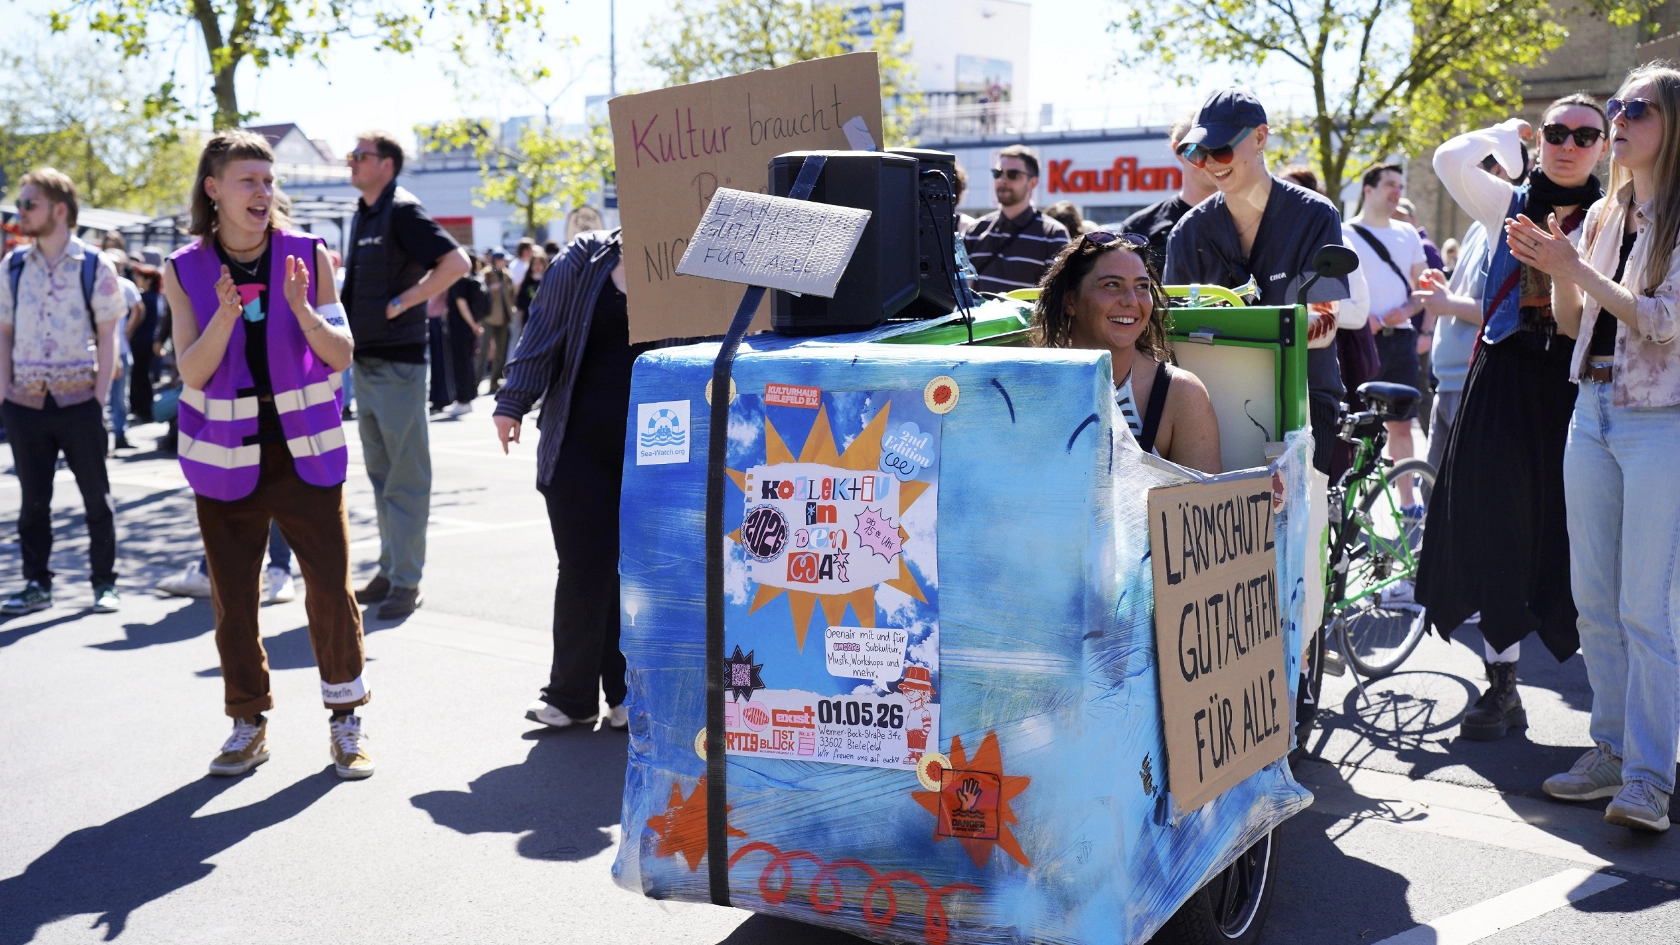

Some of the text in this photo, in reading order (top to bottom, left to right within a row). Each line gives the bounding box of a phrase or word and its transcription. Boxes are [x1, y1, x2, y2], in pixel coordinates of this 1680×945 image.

[632, 84, 842, 168] Kultur braucht
[1048, 156, 1183, 194] Kauflan
[765, 394, 804, 405] BIELEFELD
[768, 386, 818, 398] KULTURHAUS
[900, 430, 928, 449] 2nd
[640, 449, 685, 457] Sea-Watch.org
[884, 435, 929, 467] Edition
[746, 510, 786, 556] 2026
[1161, 491, 1275, 586] LÄRMSCHUTZ
[1178, 568, 1278, 683] GUTACHTEN
[826, 629, 905, 646] Openair mit und für
[833, 642, 860, 652] unsere
[887, 659, 900, 668] und
[818, 700, 904, 729] 01.05.26
[818, 725, 885, 741] Werner-Bock-Straße
[1193, 668, 1280, 783] FÜR ALLE
[820, 737, 882, 753] 33602 Bielefeld
[817, 747, 829, 758] Wir
[870, 753, 880, 764] auf
[952, 819, 986, 829] DANGER
